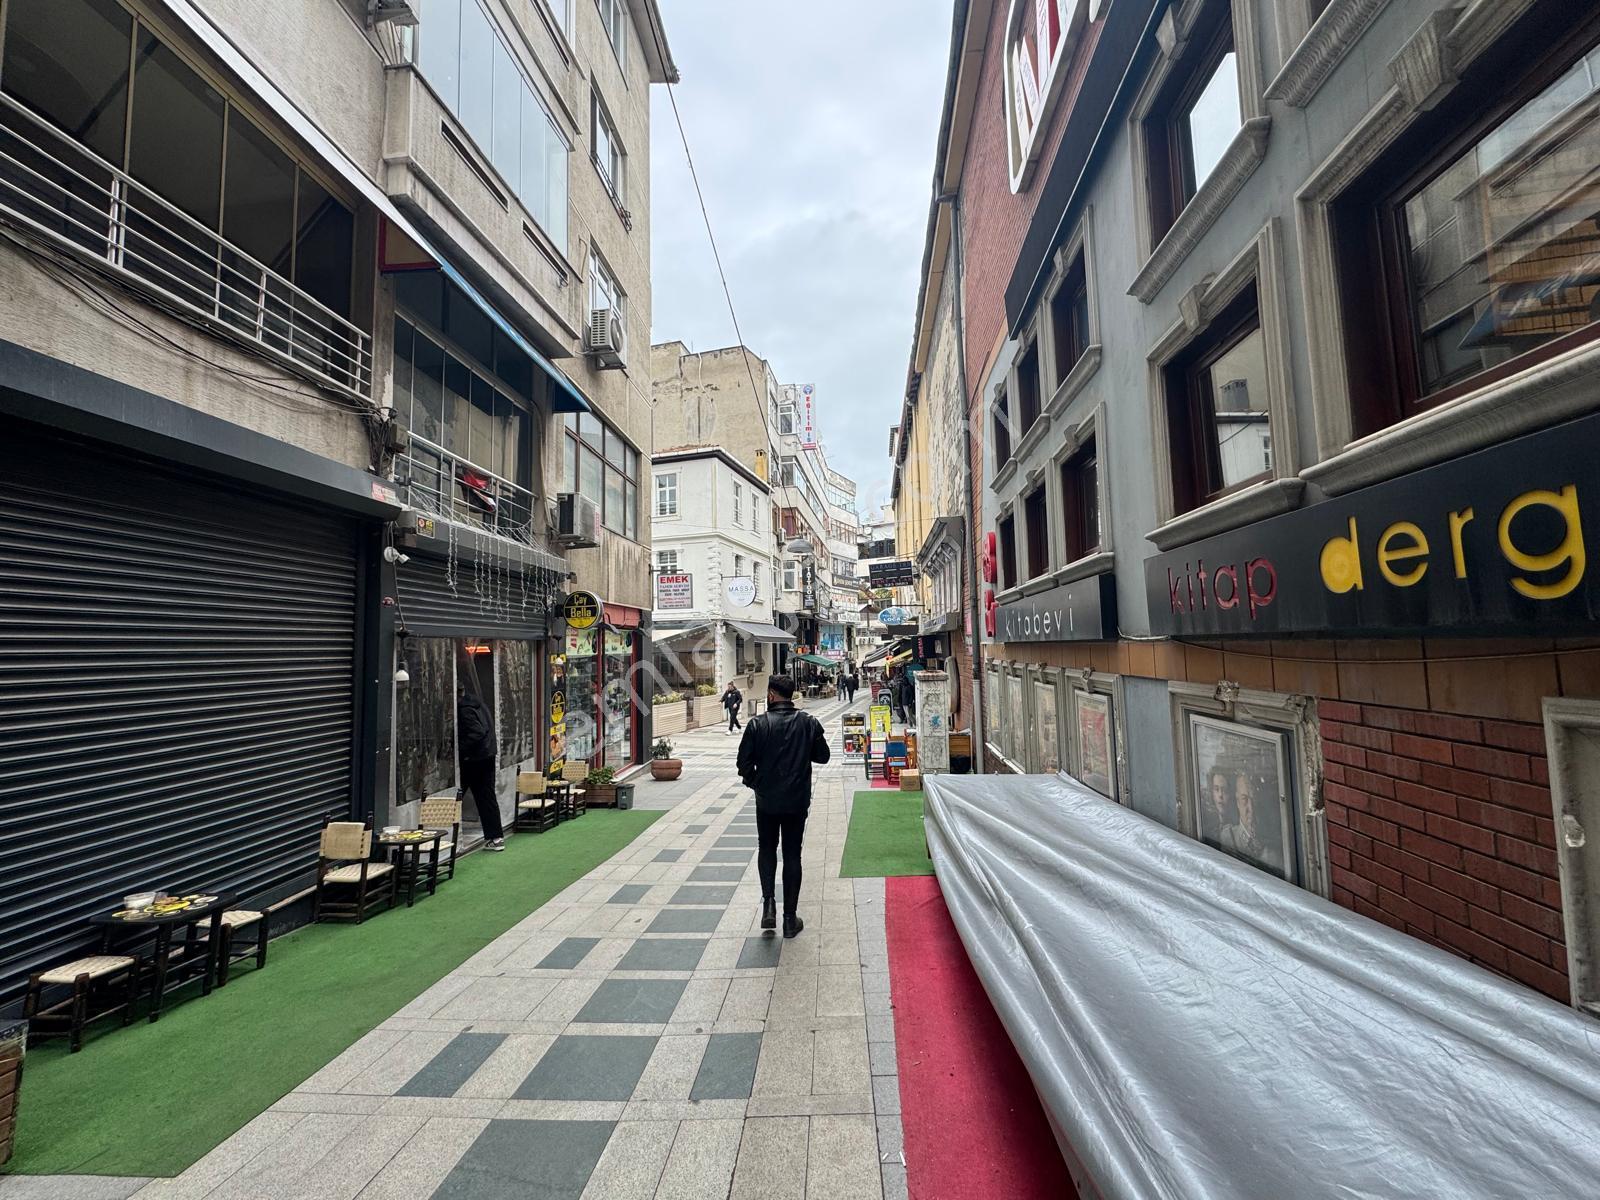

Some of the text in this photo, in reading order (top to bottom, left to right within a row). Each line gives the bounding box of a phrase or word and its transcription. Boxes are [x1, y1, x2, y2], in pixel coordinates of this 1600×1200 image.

[1318, 483, 1587, 600] derg
[660, 575, 689, 584] EMEK
[728, 585, 754, 593] MASSA
[805, 566, 813, 595] TATTOO
[1167, 555, 1279, 621] kitap
[574, 594, 587, 605] Çay
[570, 607, 592, 618] Bella
[1005, 593, 1074, 639] kitabevi
